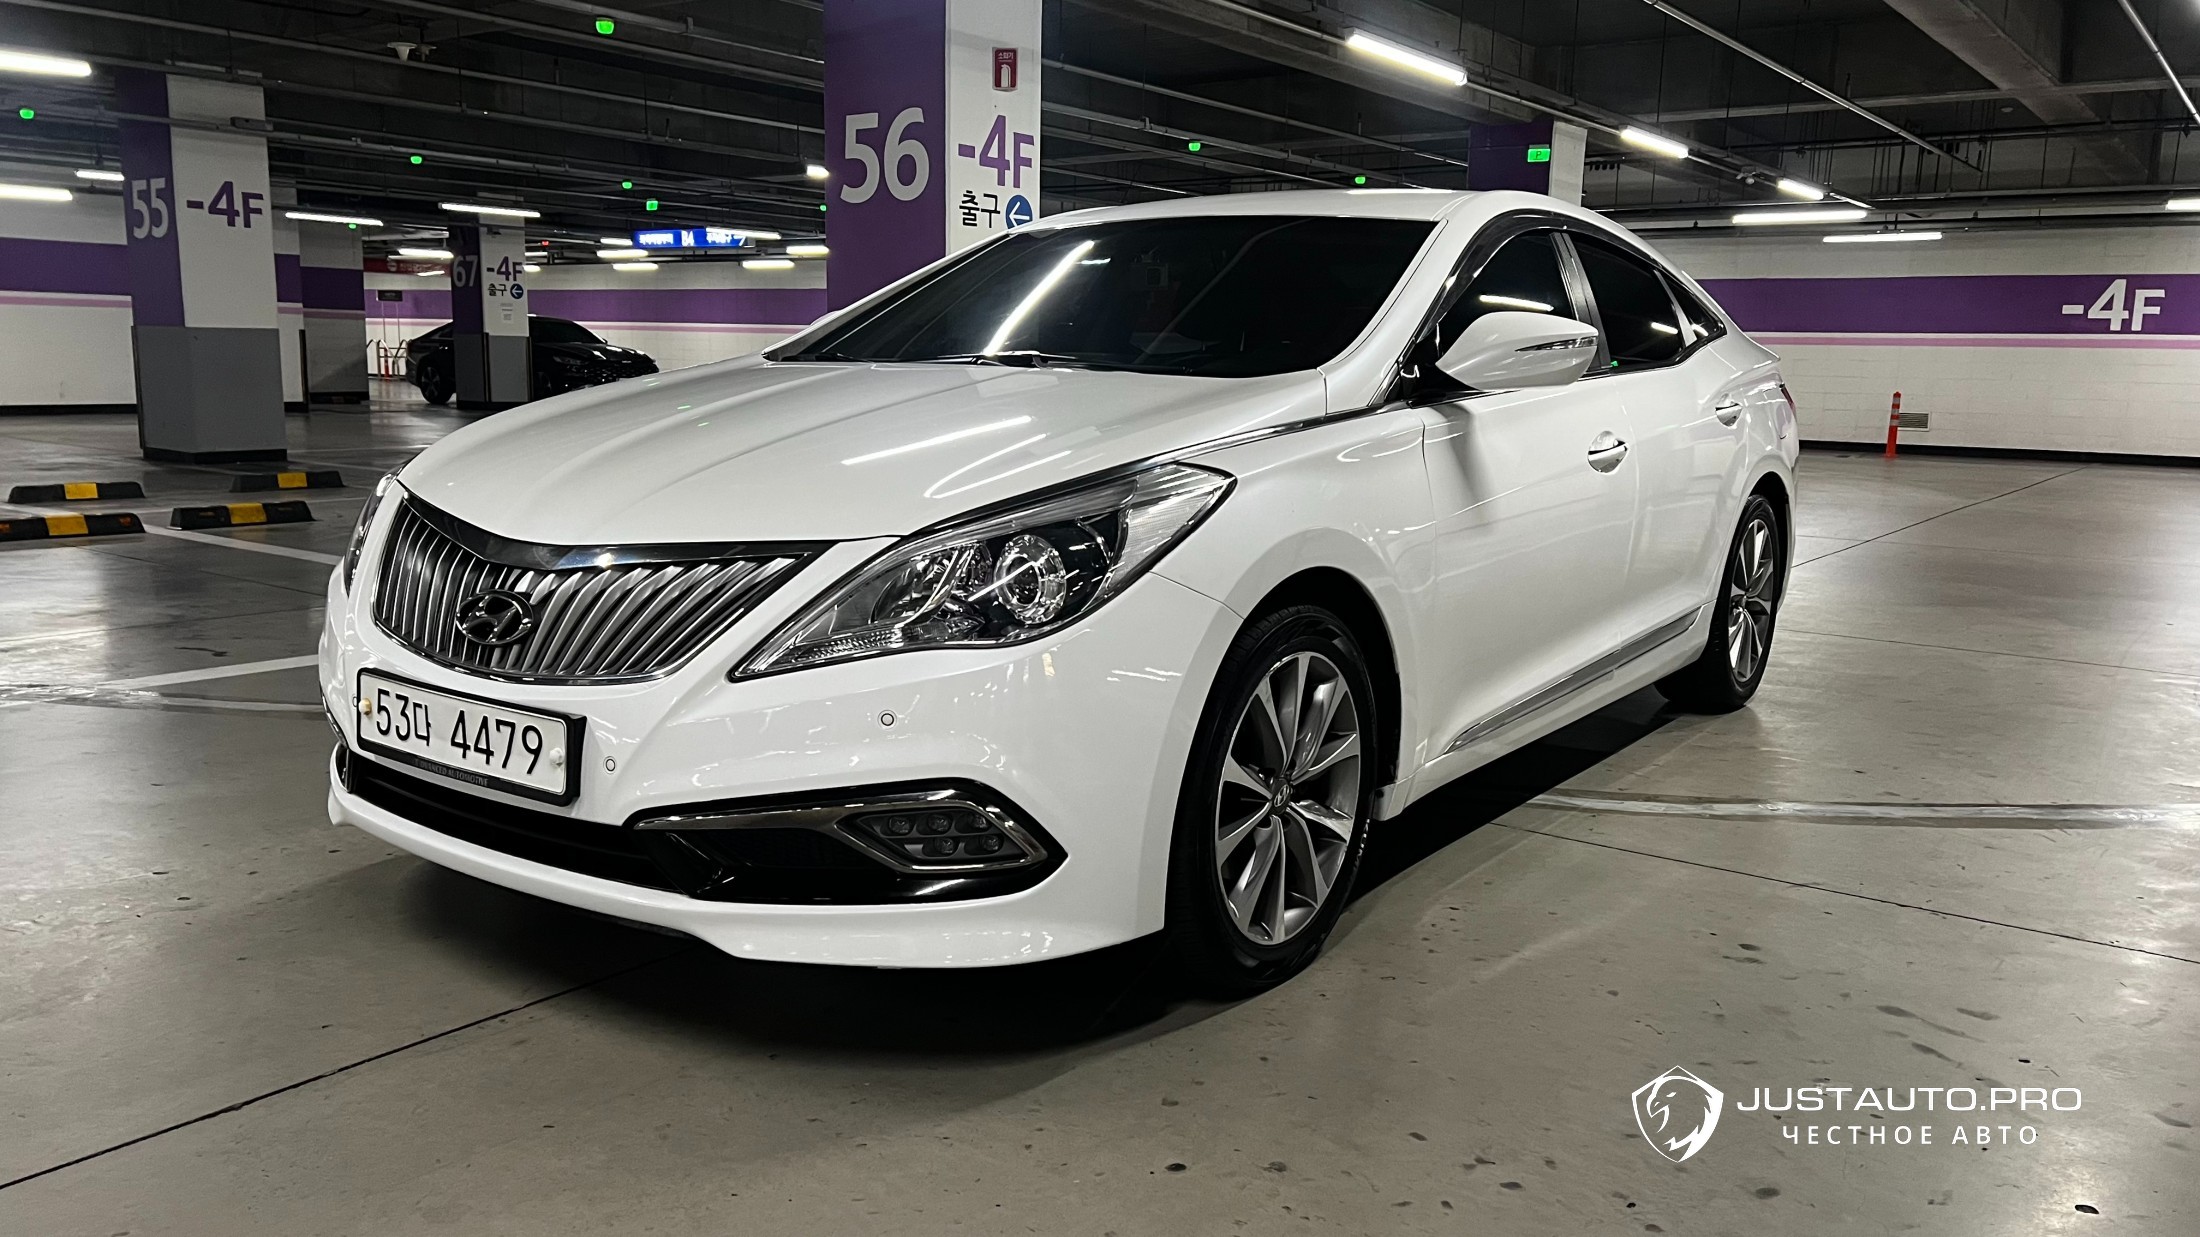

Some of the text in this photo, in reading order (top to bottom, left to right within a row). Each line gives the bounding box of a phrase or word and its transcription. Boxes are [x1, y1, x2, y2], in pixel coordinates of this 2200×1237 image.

[840, 106, 931, 204] 56
[958, 114, 1035, 188] -4F
[131, 176, 169, 240] 55
[186, 181, 264, 229] -4F
[959, 190, 1001, 228] 출구
[452, 255, 478, 287] 67
[486, 256, 523, 282] -4F
[487, 283, 507, 297] 출구
[2061, 278, 2166, 332] -4F
[376, 688, 544, 775] 53다 4479
